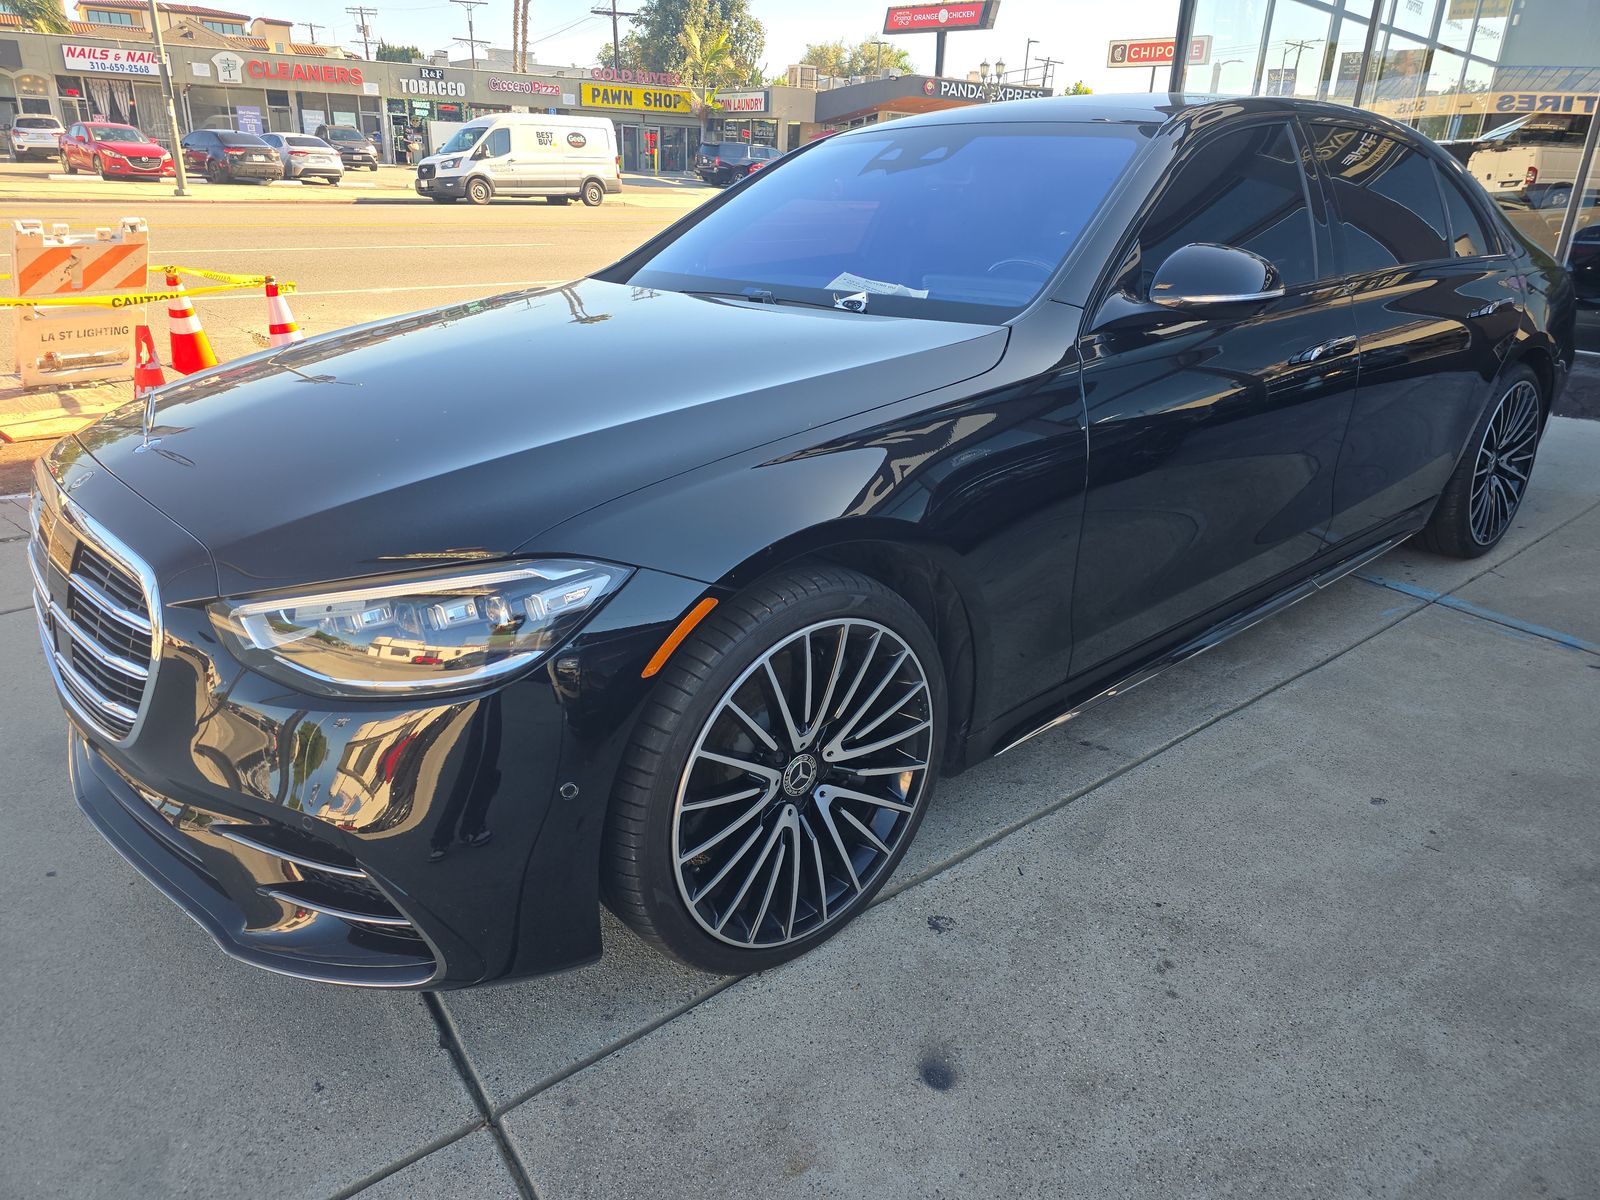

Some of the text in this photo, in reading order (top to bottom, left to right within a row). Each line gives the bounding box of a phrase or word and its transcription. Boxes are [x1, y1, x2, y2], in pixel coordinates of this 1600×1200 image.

[913, 13, 939, 21] ORANGE
[948, 10, 976, 19] CHICKEN
[66, 46, 158, 64] NAILS & NAIL
[1130, 43, 1201, 59] CHIPOE
[89, 61, 150, 74] 310-659-2568
[248, 60, 363, 86] CLEANERS
[421, 68, 443, 79] R&F
[591, 67, 632, 81] GOLD
[400, 78, 466, 97] TOBACCO
[940, 81, 985, 99] PANDA
[591, 87, 683, 109] PAWN SHOP
[733, 97, 763, 111] LAUNDRY
[535, 131, 553, 139] BEST
[538, 138, 553, 146] BUY
[41, 325, 129, 343] LA ST LIGHTING
